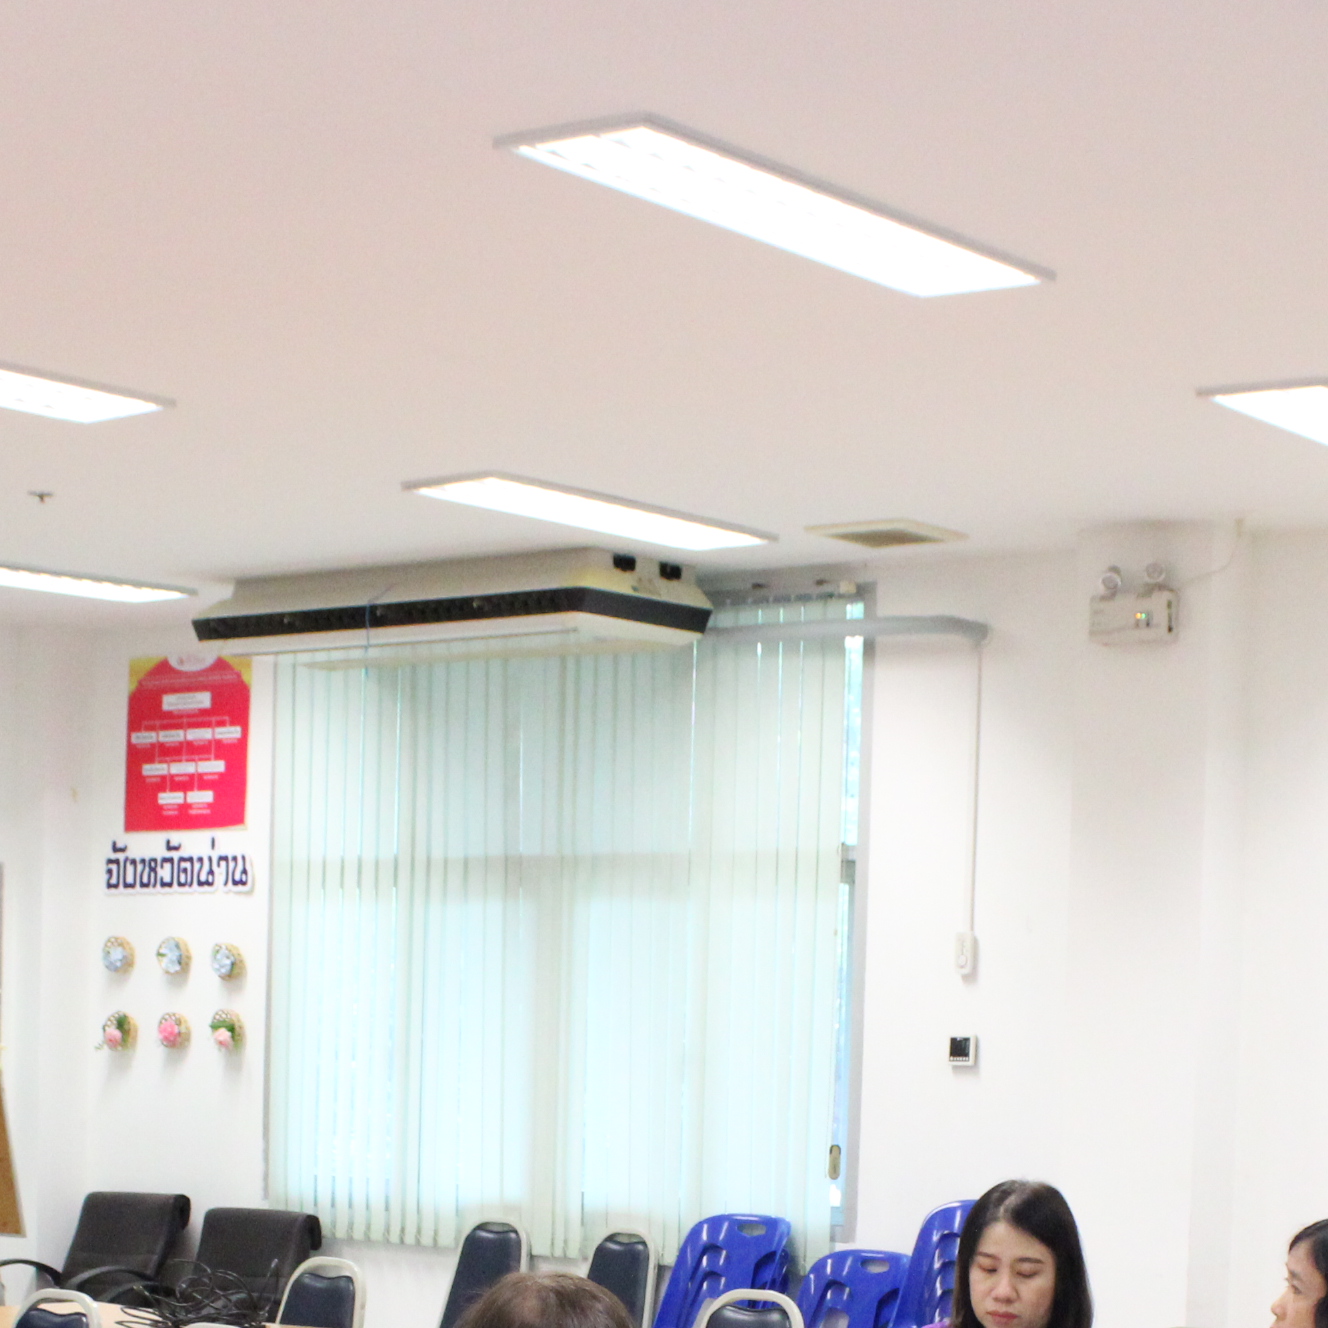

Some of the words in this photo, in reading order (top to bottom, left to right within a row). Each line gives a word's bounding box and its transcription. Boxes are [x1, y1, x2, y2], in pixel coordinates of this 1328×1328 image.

[105, 836, 249, 889] จังหวัดน่าน
